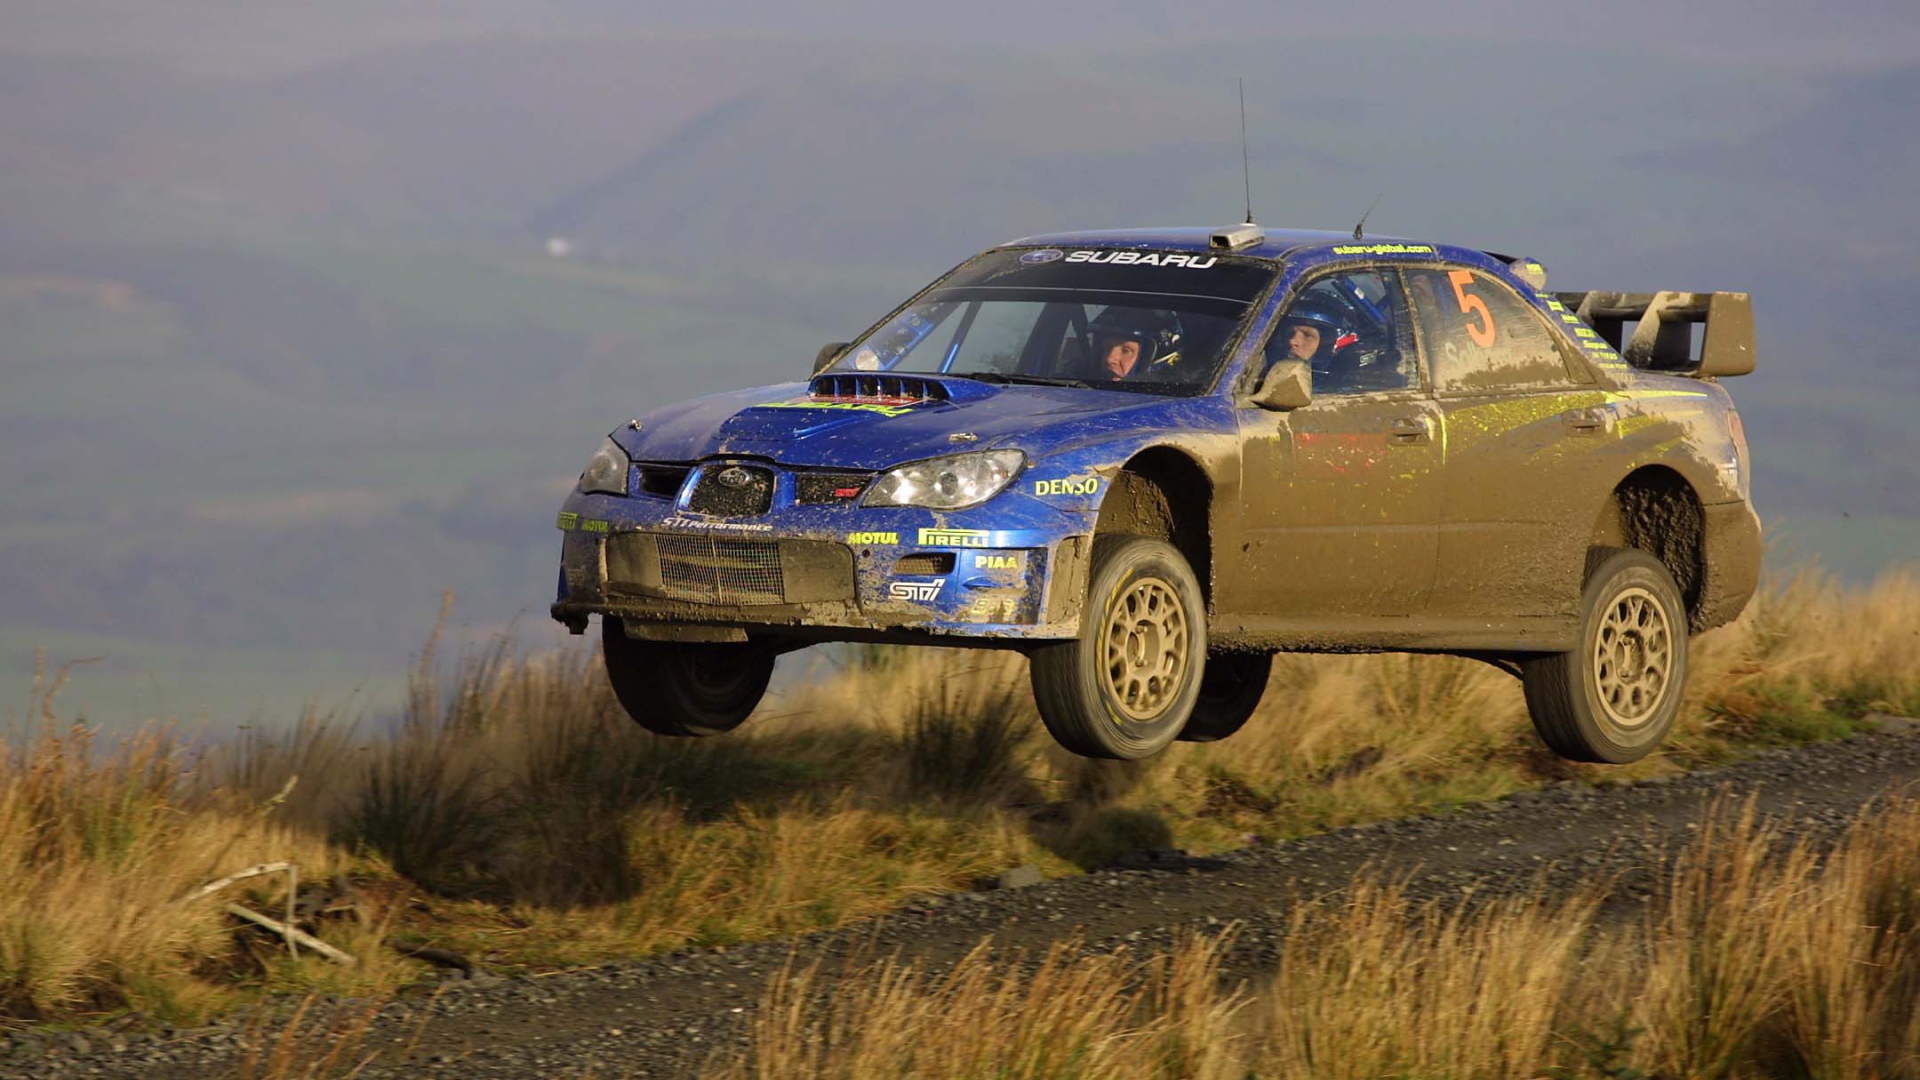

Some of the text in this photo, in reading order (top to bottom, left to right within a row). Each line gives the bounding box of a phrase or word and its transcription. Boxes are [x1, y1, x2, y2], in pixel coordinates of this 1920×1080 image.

[1333, 244, 1432, 255] subaru-global.com
[1065, 251, 1218, 269] SUBARU
[1447, 270, 1496, 348] 5
[1035, 478, 1099, 496] DENSO
[687, 521, 773, 531] Performance
[848, 532, 899, 545] MOTUL
[918, 528, 989, 547] PIRELLI
[975, 555, 1018, 569] PIAA
